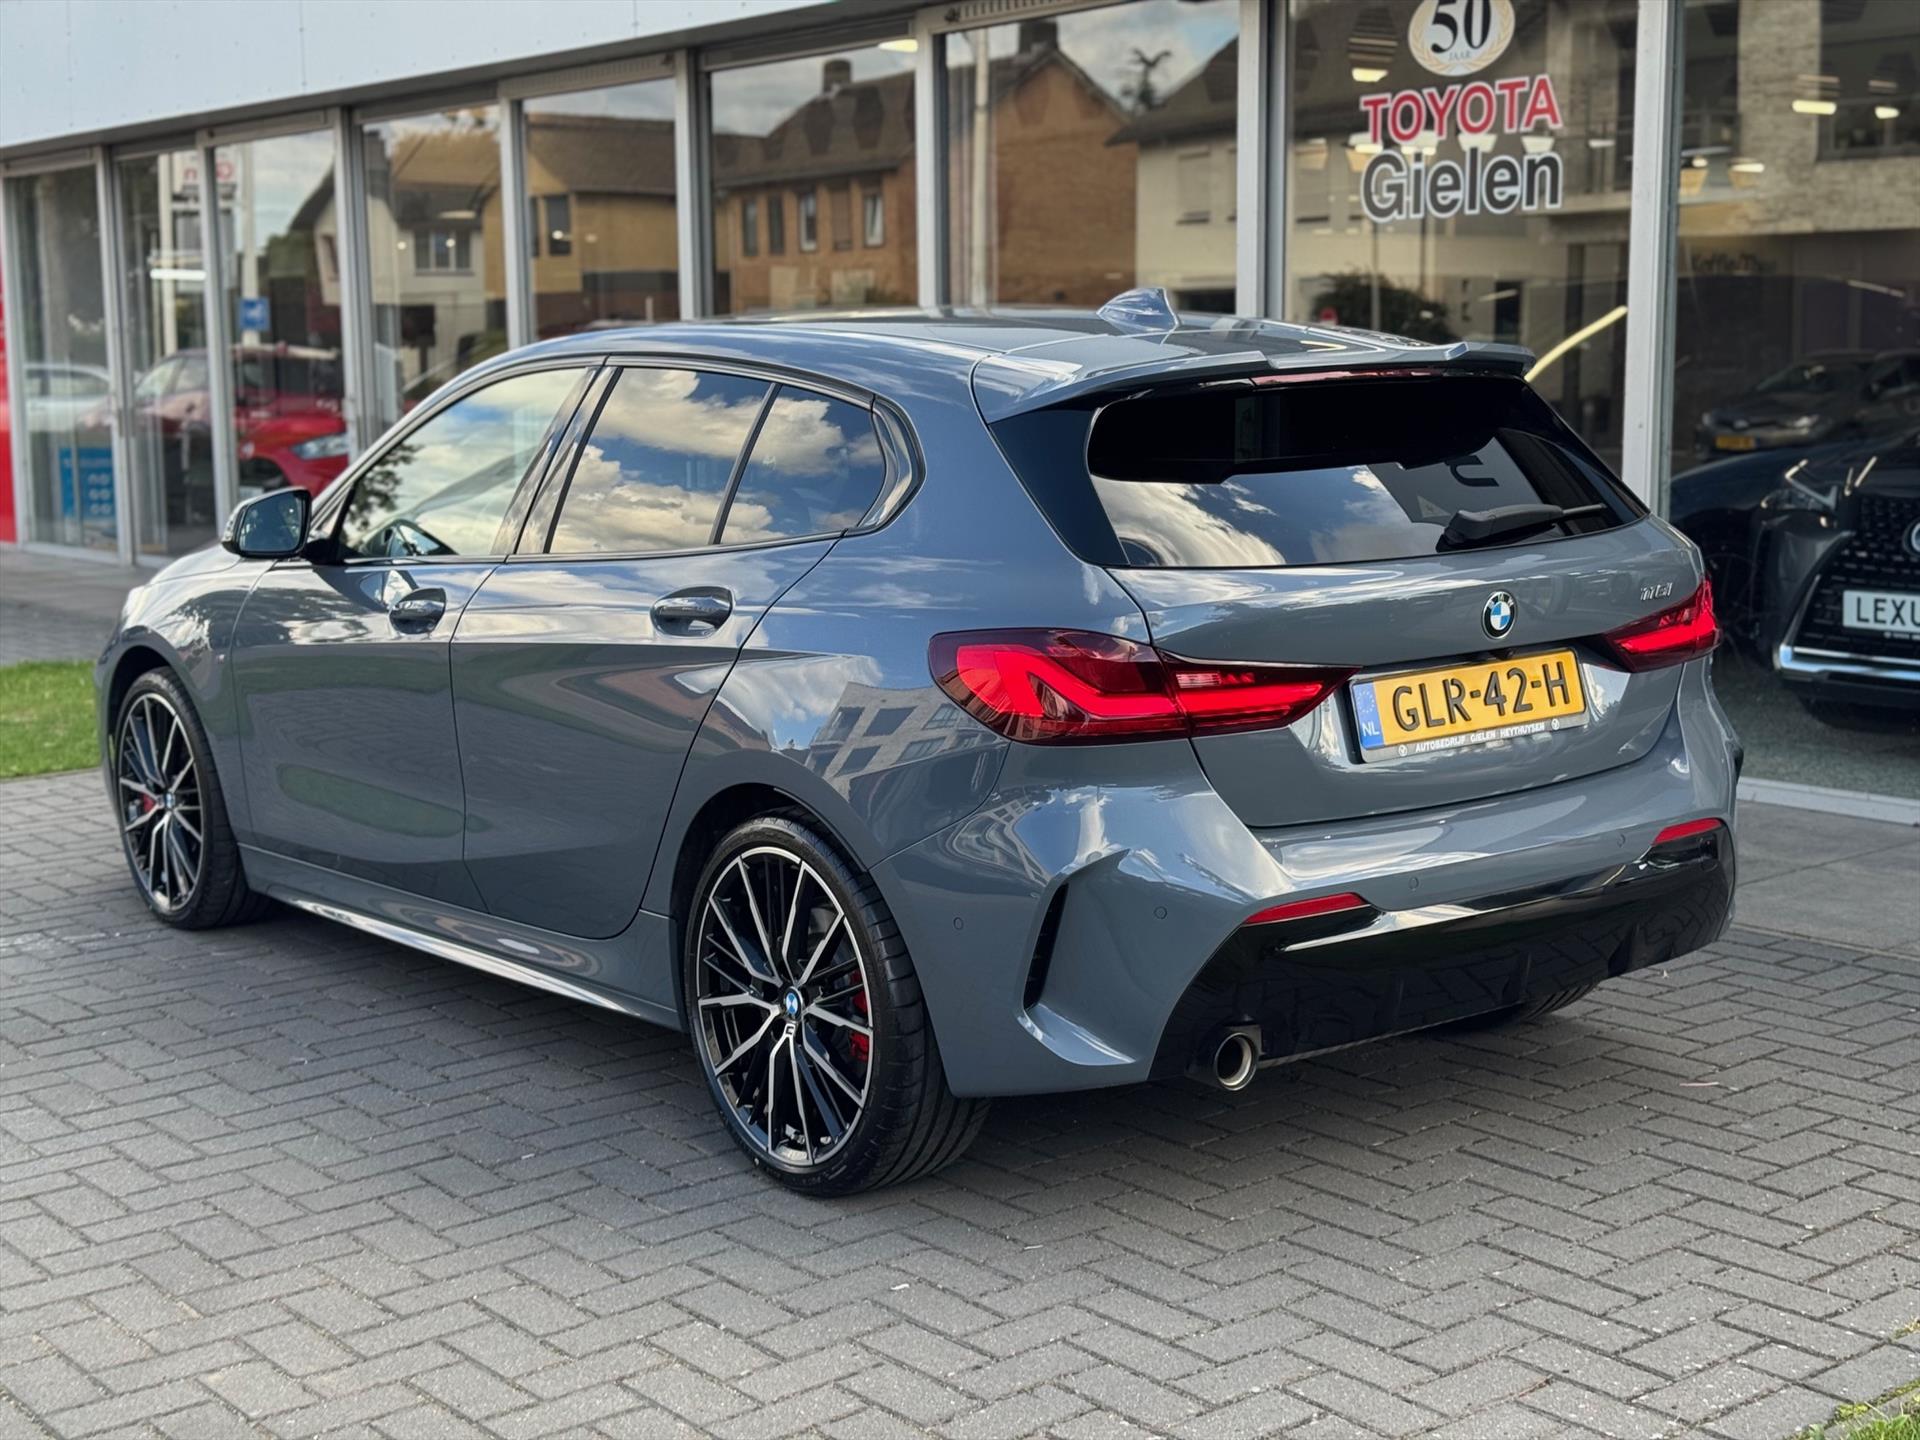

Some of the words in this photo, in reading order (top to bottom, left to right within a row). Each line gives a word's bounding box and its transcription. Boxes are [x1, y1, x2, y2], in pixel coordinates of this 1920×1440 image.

[1431, 0, 1492, 53] 50
[1360, 74, 1562, 146] TOYOTA
[1360, 147, 1563, 223] Gielen
[1392, 661, 1571, 732] GLR-42-H
[1361, 721, 1381, 736] NL
[1415, 734, 1466, 753] AUTOBEDRIJF
[1470, 728, 1496, 742] GIELEN
[1500, 722, 1546, 738] HEYTHUYSEN
